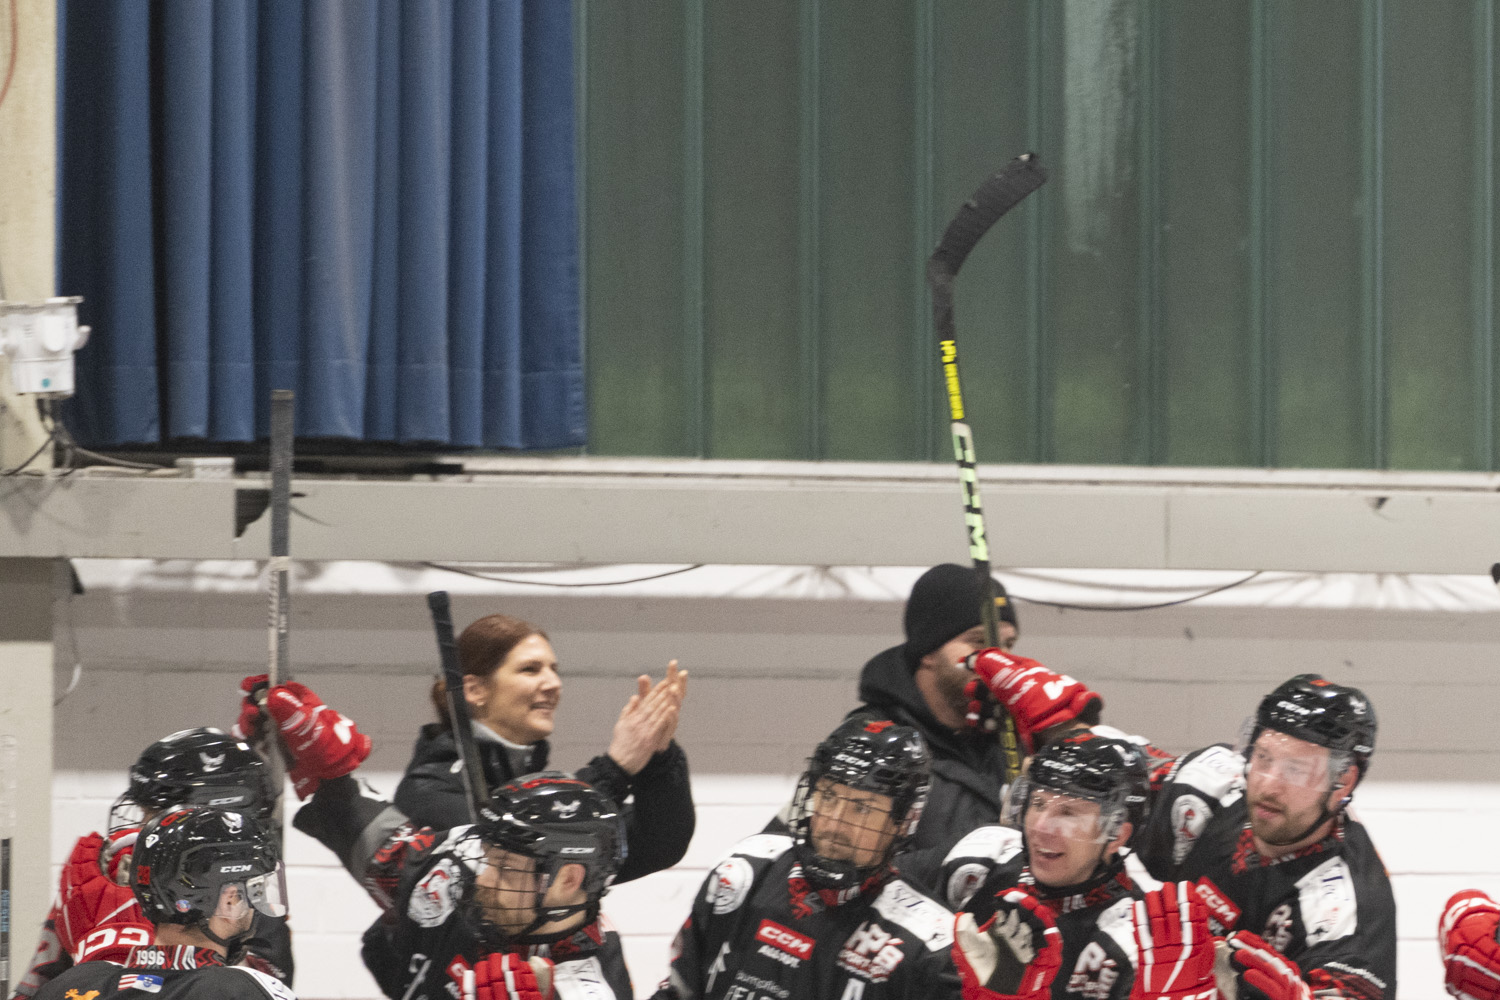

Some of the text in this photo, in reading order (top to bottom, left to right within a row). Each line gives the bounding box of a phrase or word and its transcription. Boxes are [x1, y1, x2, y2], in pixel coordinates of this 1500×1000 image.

[220, 864, 252, 873] CCM
[1195, 883, 1238, 922] CCM
[759, 925, 812, 954] CCM
[136, 946, 165, 966] 1996
